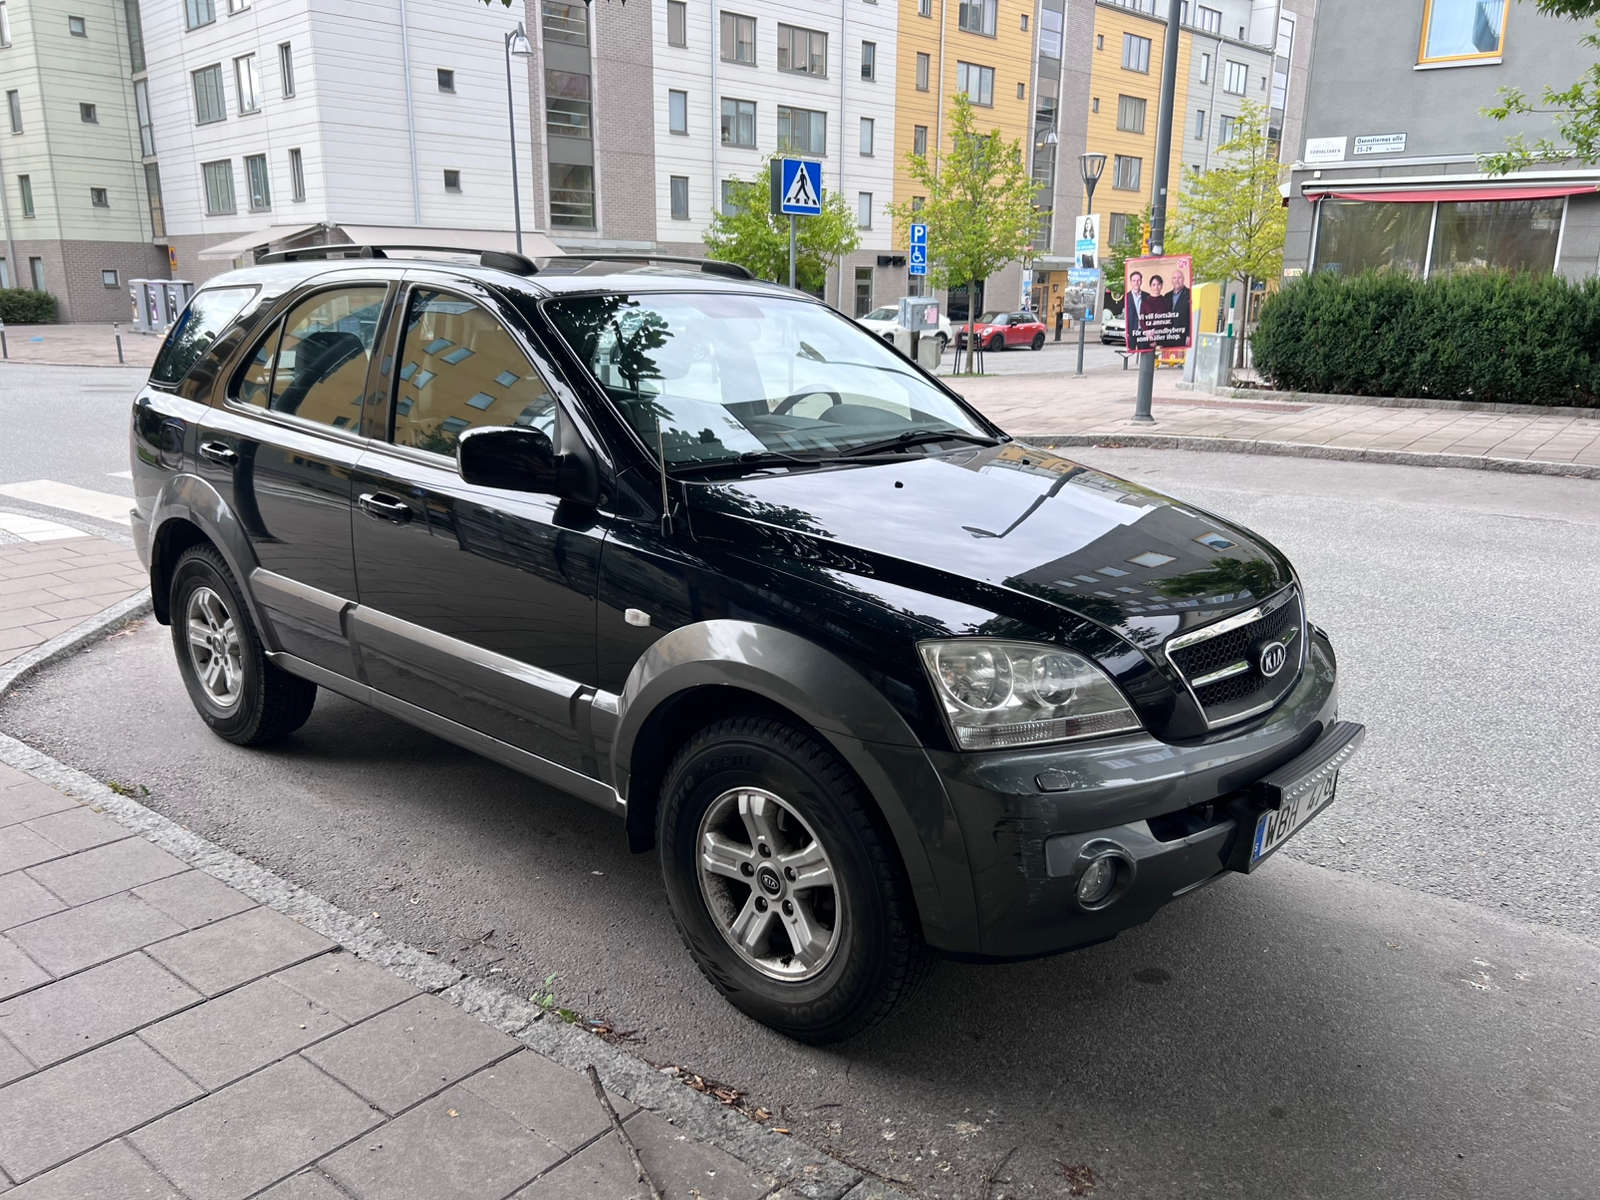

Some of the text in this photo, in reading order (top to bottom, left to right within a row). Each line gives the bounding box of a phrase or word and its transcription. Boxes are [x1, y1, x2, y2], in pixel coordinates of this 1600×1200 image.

[1357, 136, 1391, 144] Oxenstiernas
[914, 226, 924, 243] P
[1154, 311, 1179, 319] fortsätta
[1132, 329, 1142, 337] För
[1150, 327, 1186, 335] Sundbyberg
[1149, 334, 1166, 342] håller
[1265, 648, 1283, 671] KIA
[1264, 800, 1300, 849] WBH
[764, 876, 776, 888] KIA
